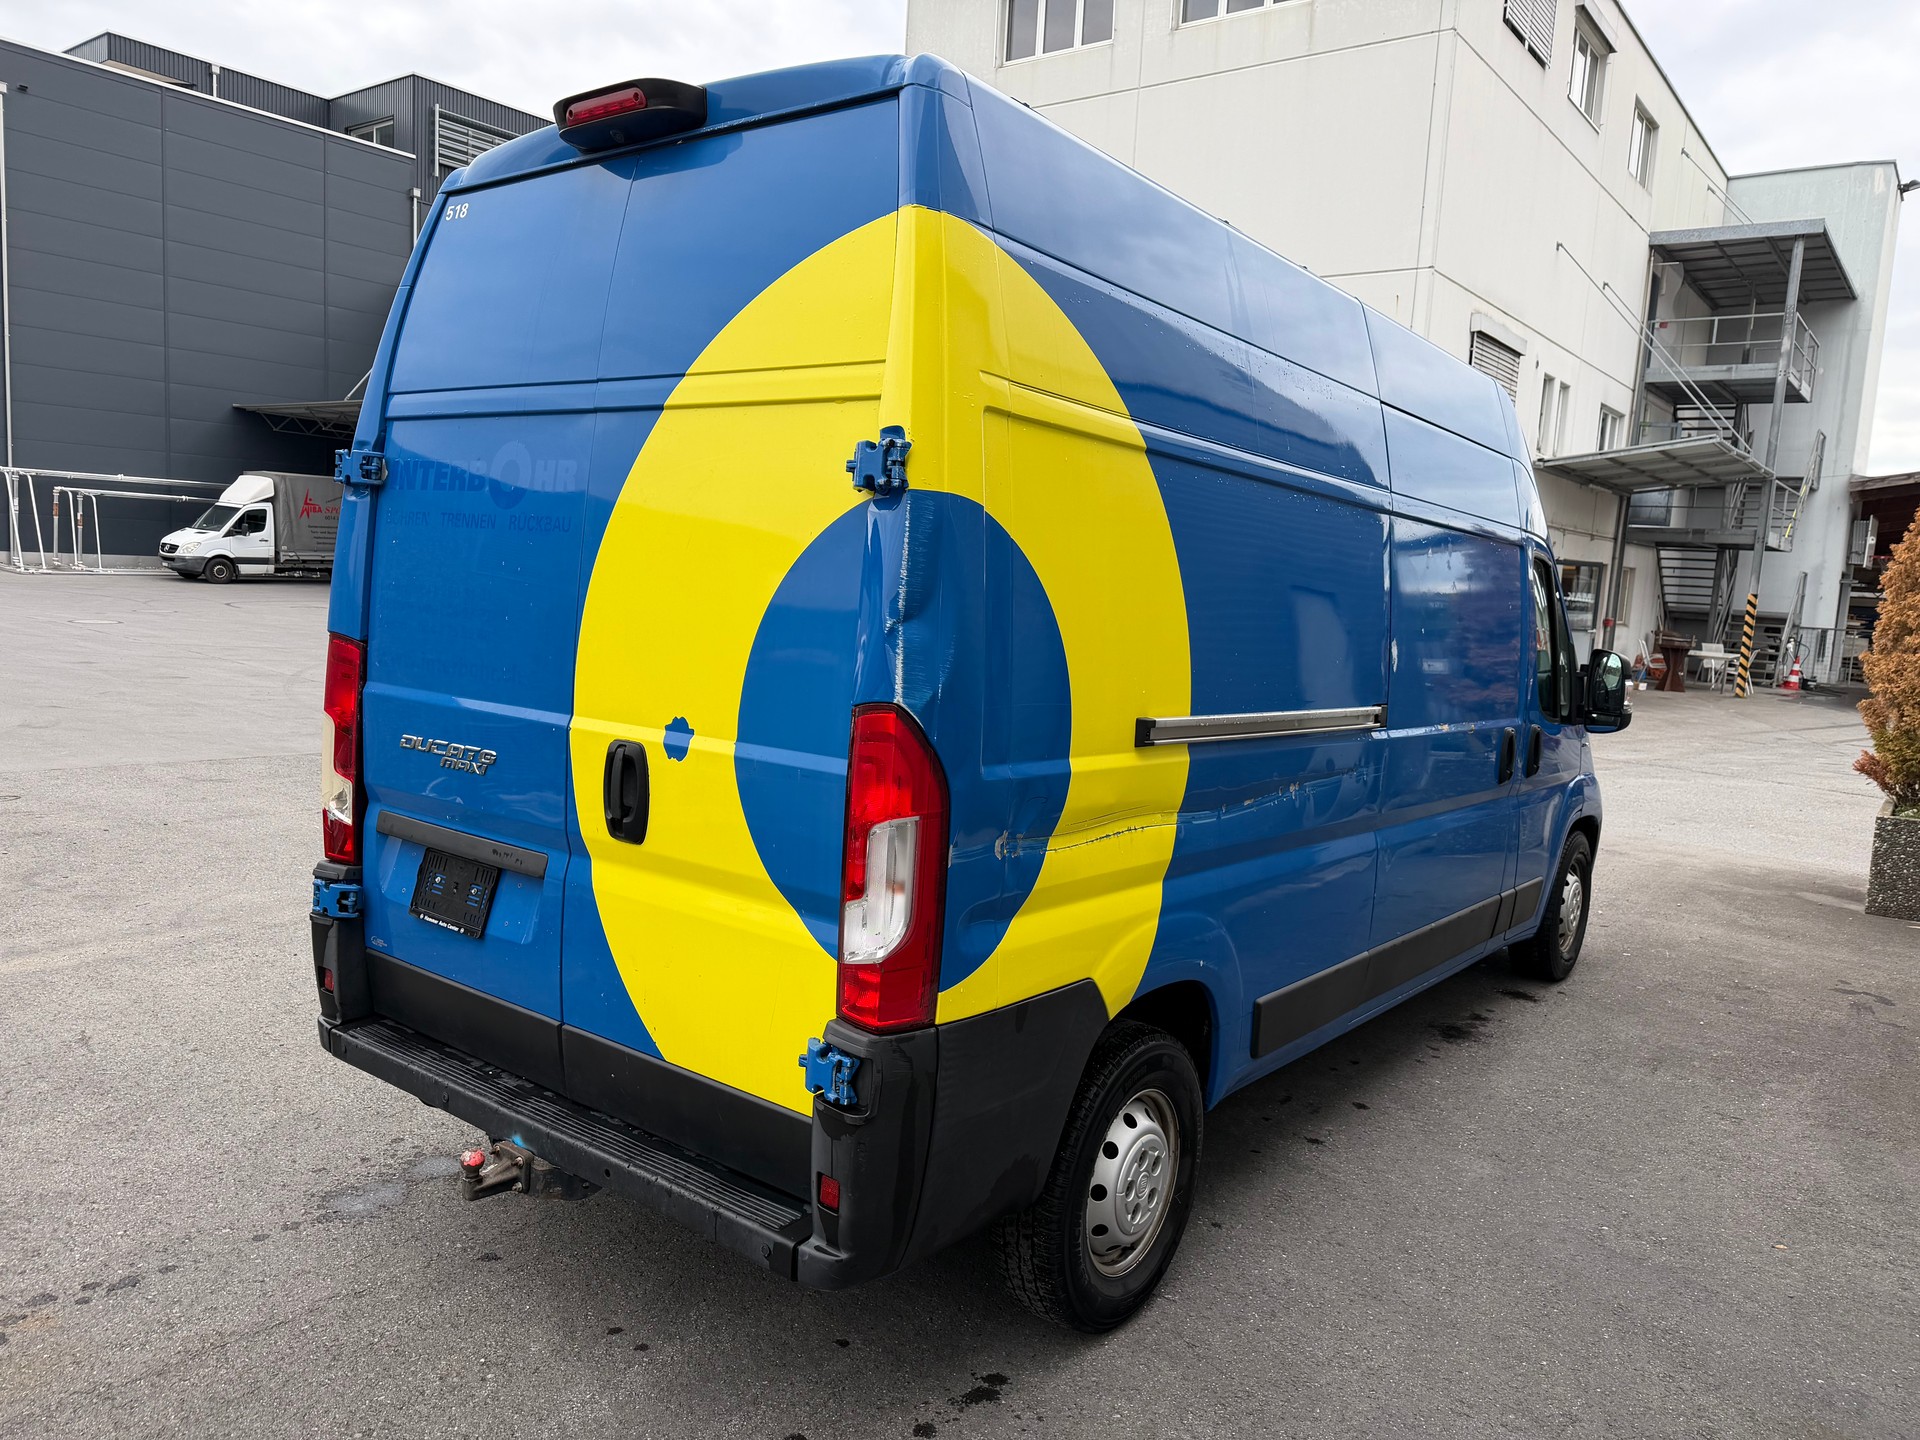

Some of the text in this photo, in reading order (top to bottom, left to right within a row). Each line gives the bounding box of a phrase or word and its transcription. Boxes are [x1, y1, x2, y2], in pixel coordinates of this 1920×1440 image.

[445, 202, 469, 221] 518
[441, 512, 497, 530] TRENNEN
[508, 511, 573, 533] RÜCKBAU
[400, 734, 497, 764] DUCATO
[440, 756, 489, 776] MAXI
